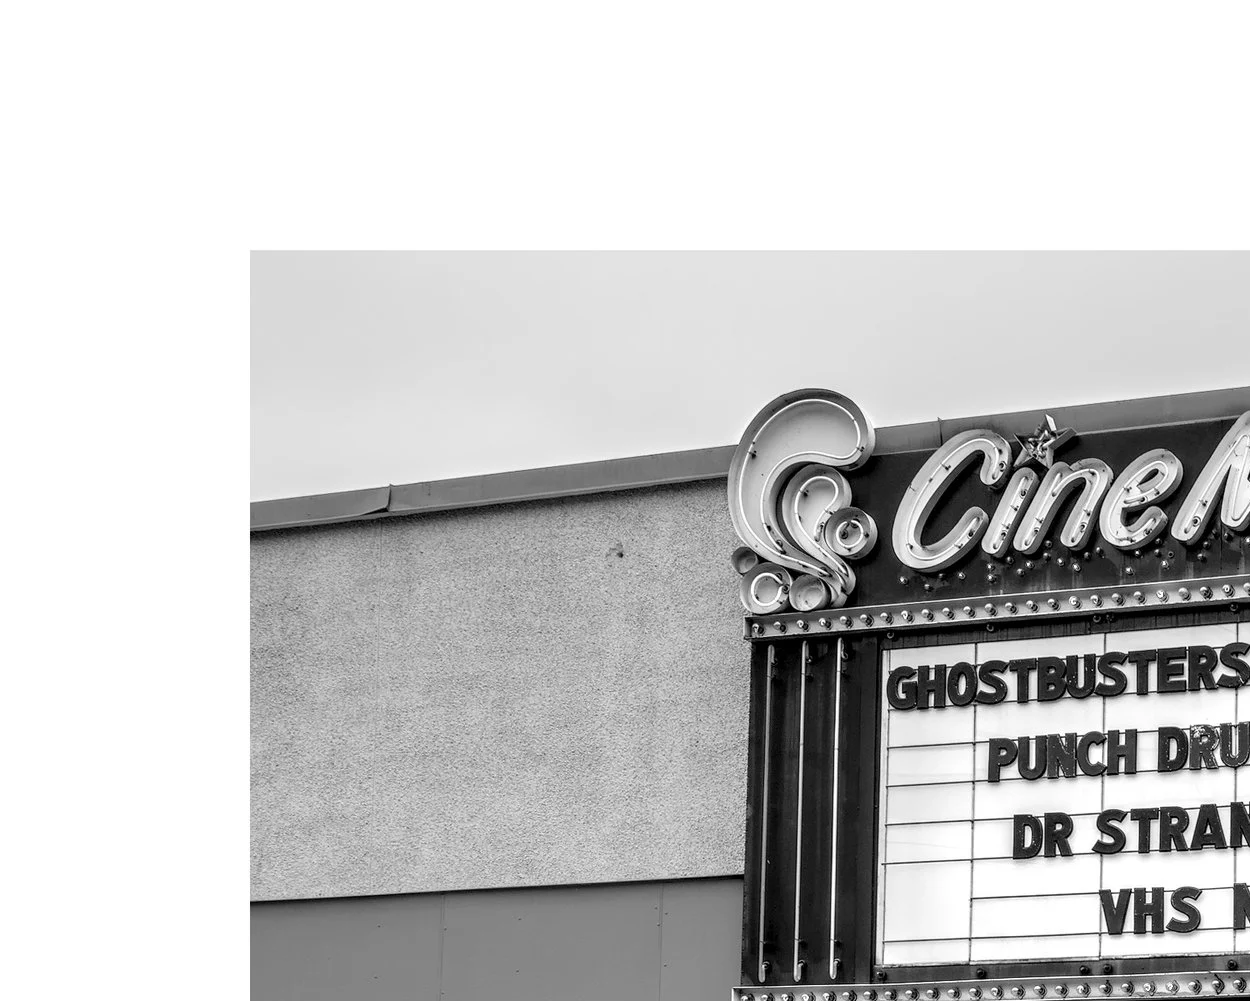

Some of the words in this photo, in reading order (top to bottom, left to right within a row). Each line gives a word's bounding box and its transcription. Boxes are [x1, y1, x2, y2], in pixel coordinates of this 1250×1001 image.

[988, 728, 1138, 782] PUNCH
[1012, 813, 1075, 860] DR
[1098, 886, 1204, 935] VHS
